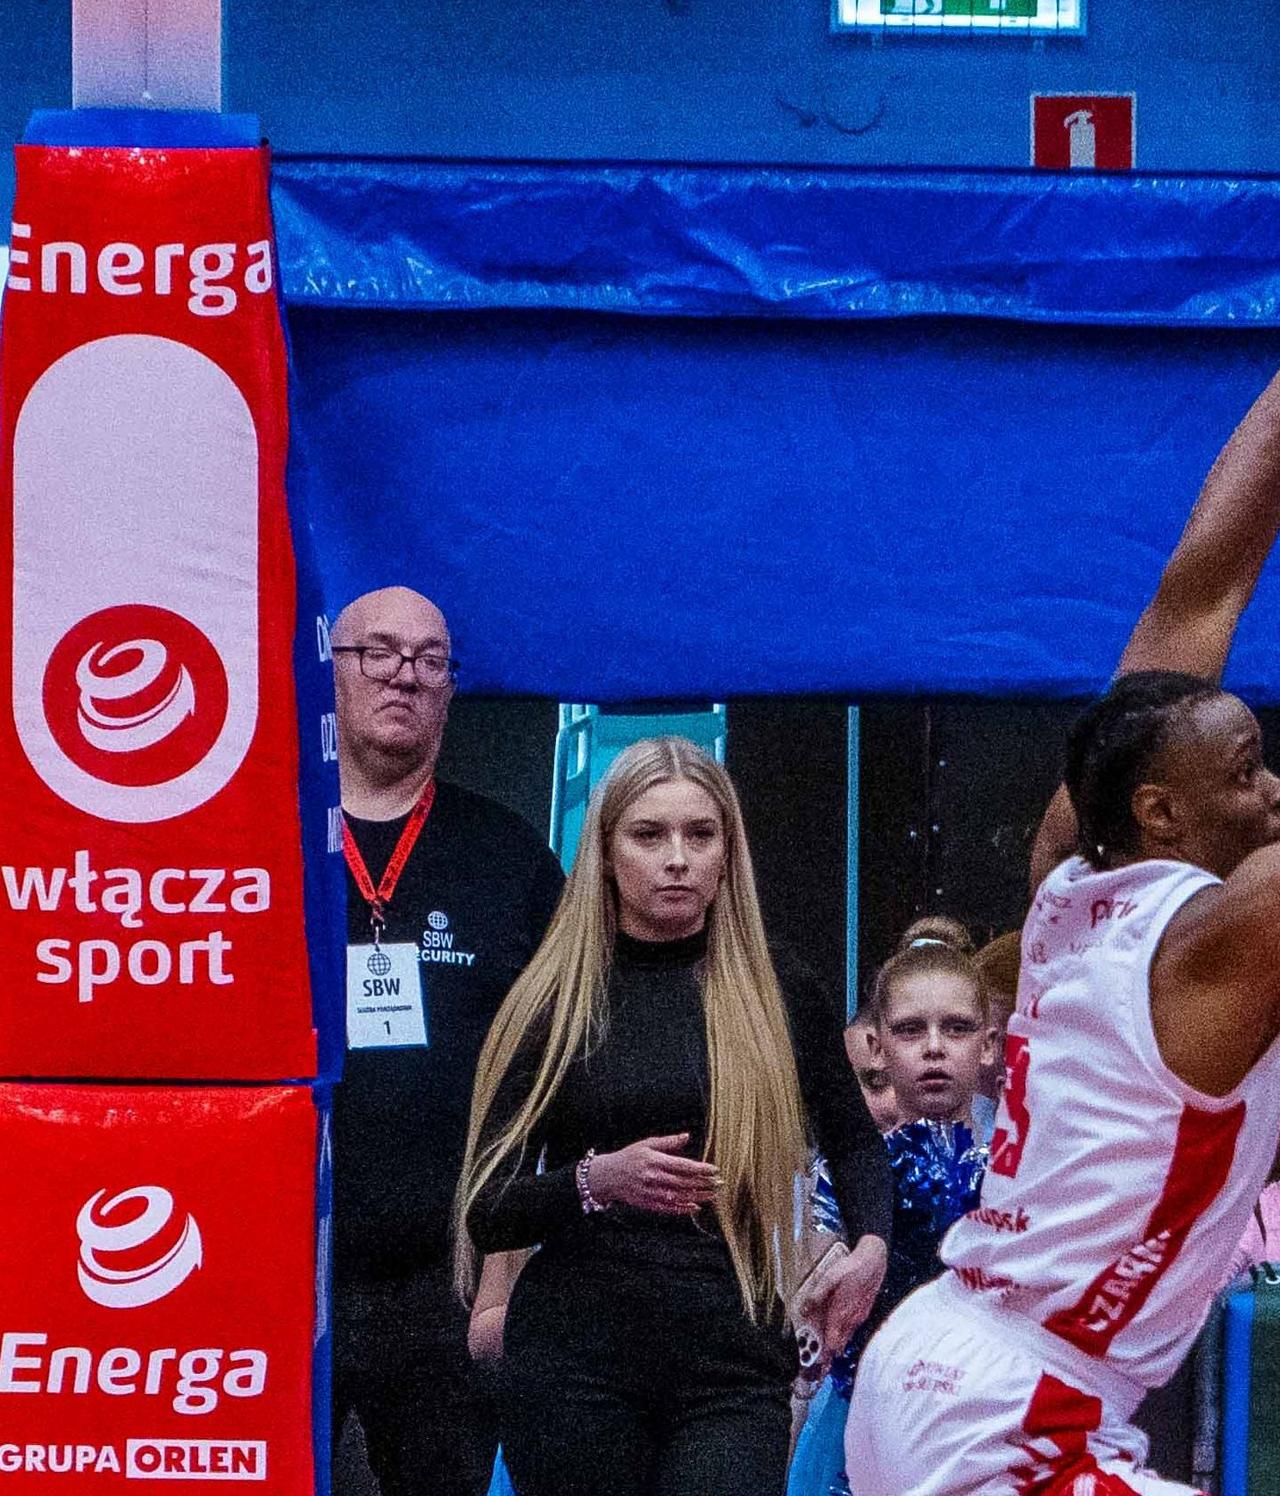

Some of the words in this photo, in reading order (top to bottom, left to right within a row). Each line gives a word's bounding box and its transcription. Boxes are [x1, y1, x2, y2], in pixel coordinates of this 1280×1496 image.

[8, 222, 273, 317] Energa
[1, 849, 271, 929] włącza
[422, 930, 454, 949] SBW
[36, 930, 234, 1003] sport
[416, 949, 476, 967] ECURITY
[362, 977, 401, 998] SBW
[383, 1020, 391, 1036] 1
[0, 1331, 269, 1416] Energa
[0, 1443, 121, 1474] GRUPA
[134, 1445, 257, 1474] ORLEN
